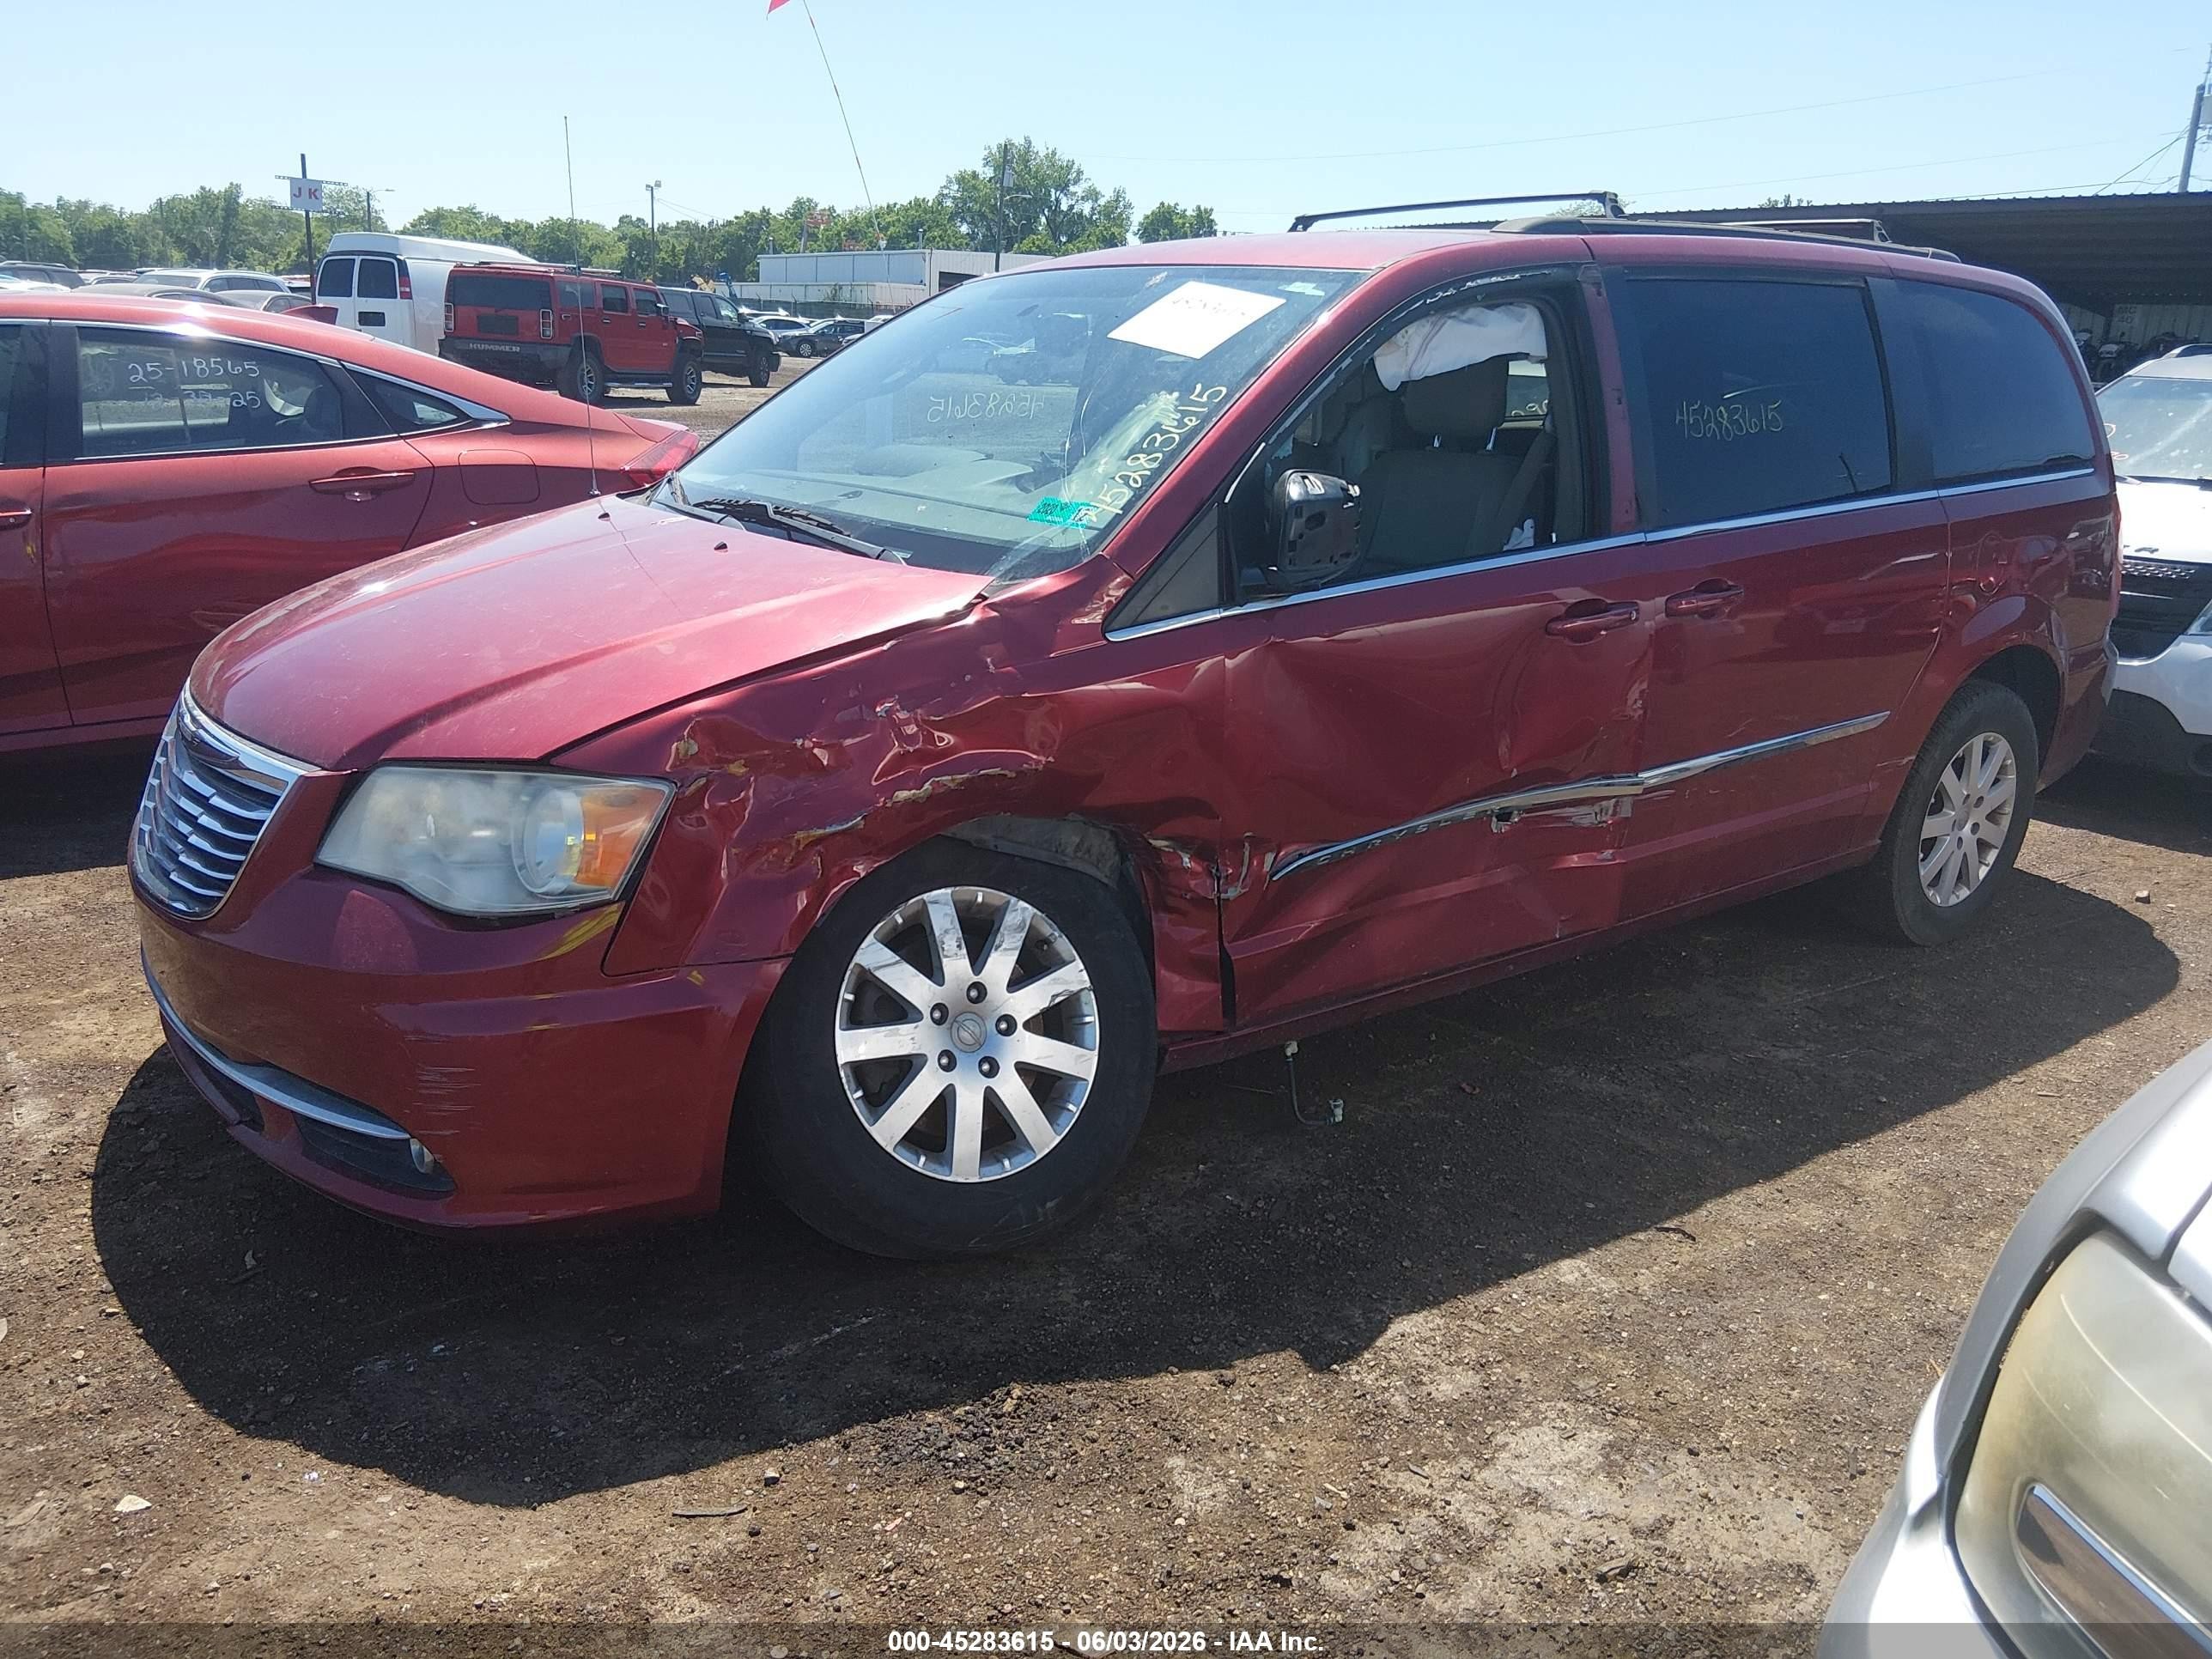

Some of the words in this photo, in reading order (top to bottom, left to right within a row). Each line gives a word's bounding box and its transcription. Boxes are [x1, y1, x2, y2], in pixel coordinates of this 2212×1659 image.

[293, 186, 301, 198] J
[308, 187, 319, 199] K
[469, 343, 520, 352] HUMMER
[128, 357, 260, 383] 25-18565
[1675, 399, 1783, 441] 45283615
